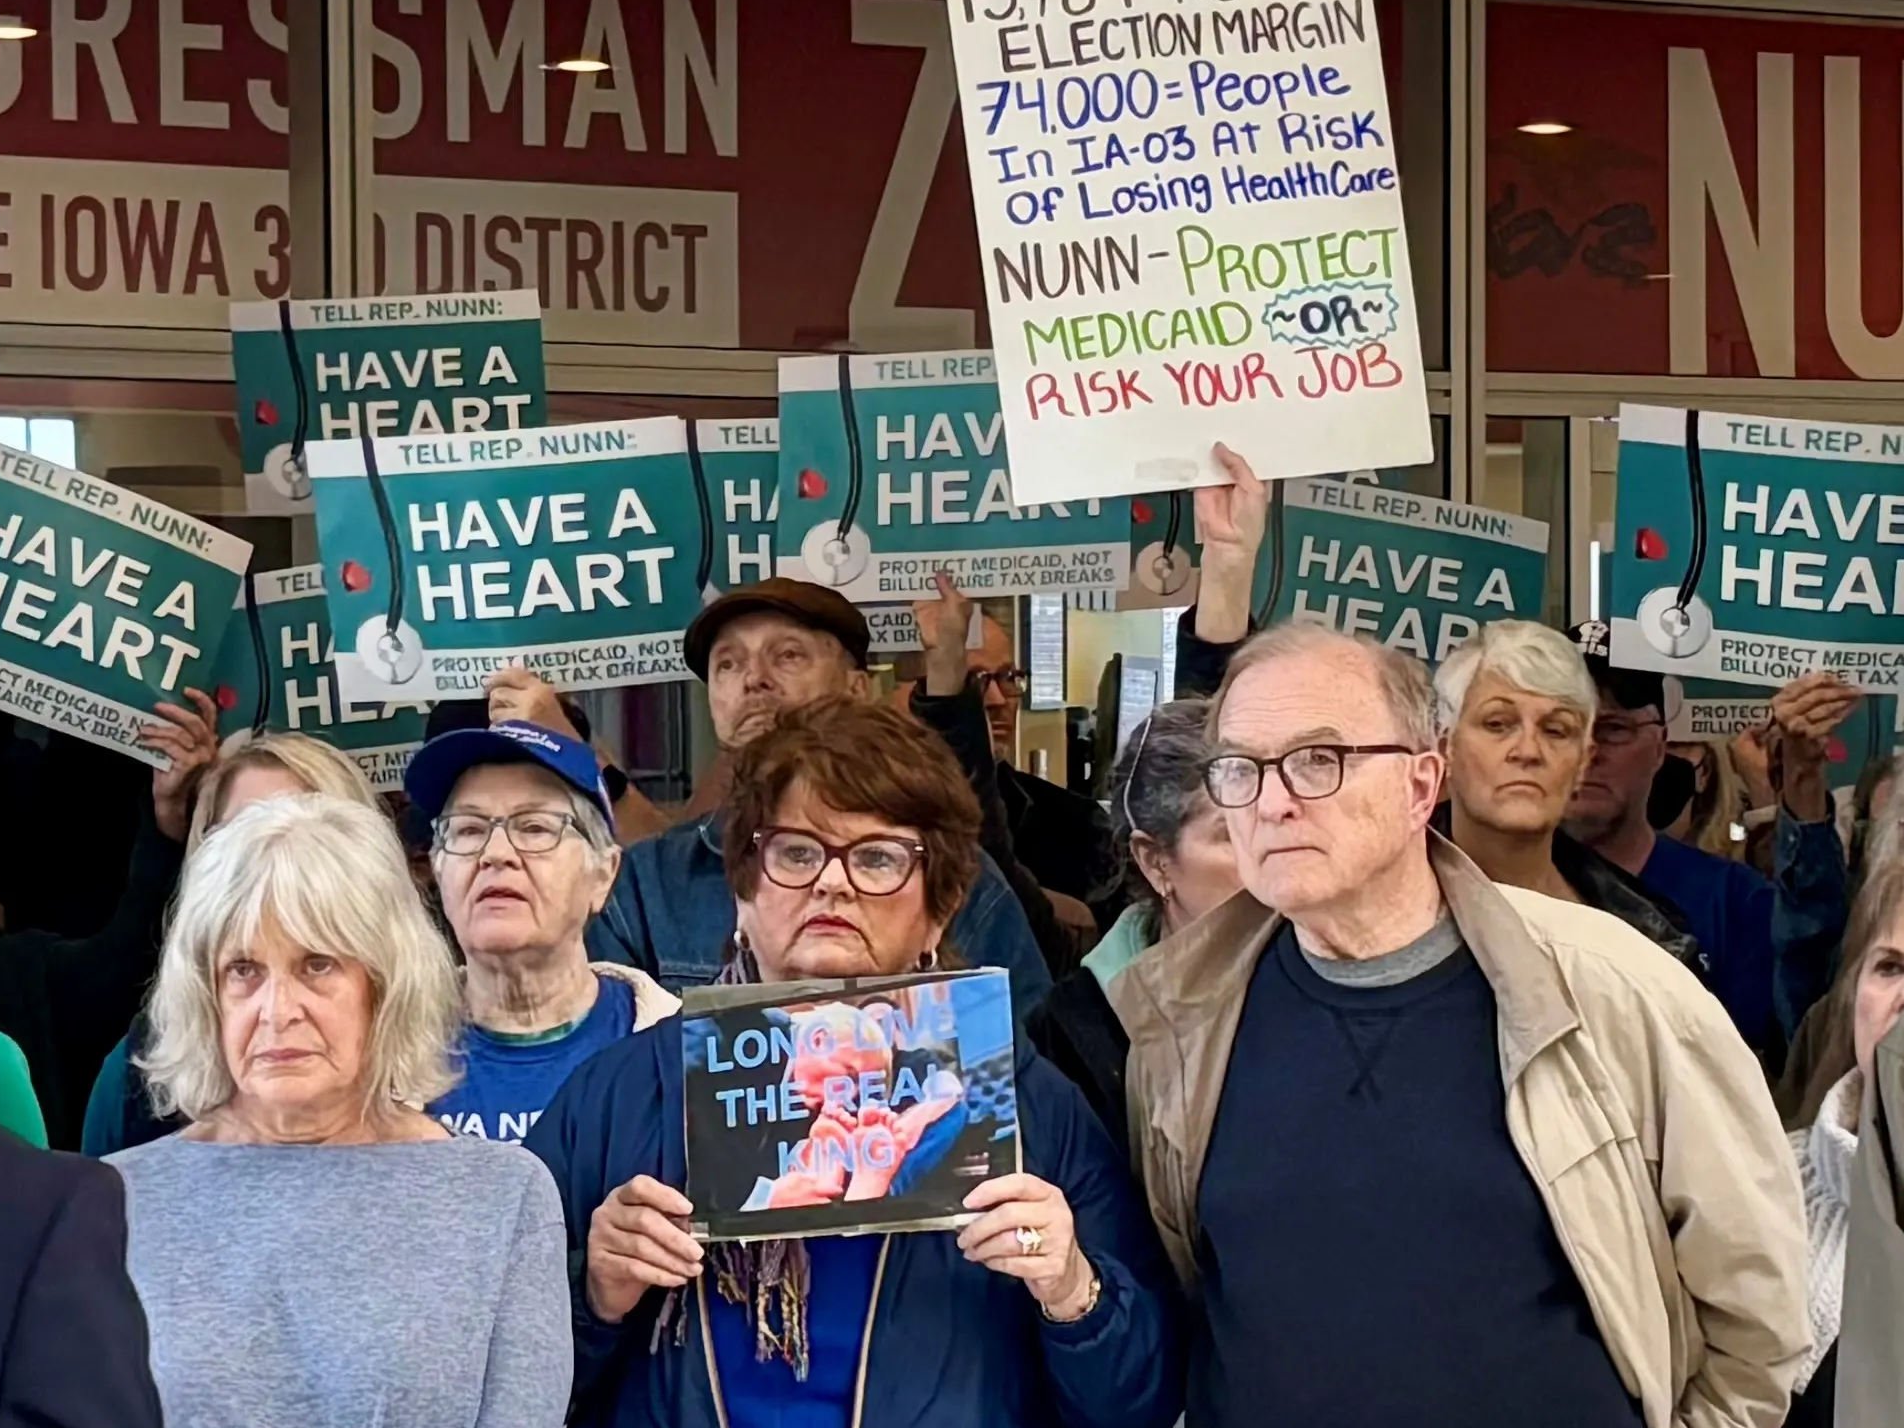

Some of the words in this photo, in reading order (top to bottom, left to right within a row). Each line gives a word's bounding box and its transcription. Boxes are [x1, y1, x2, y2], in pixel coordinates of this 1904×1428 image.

[998, 12, 1202, 74] ELECTION
[1068, 125, 1197, 175] IA-03
[1079, 173, 1213, 221] Losing
[40, 193, 231, 298] IOWA
[416, 211, 708, 315] DISTRICT
[310, 304, 364, 323] TELL
[369, 302, 421, 321] REP.
[425, 298, 503, 319] NUNN:
[1023, 300, 1253, 366] MEDICAID
[315, 346, 464, 393] HAVE
[478, 345, 519, 386] A
[874, 359, 936, 381] TELL
[1026, 369, 1154, 420] RISK
[1163, 351, 1283, 407] YOUR
[1295, 341, 1404, 399] JOB
[399, 443, 463, 467] TELL
[470, 437, 534, 462] REP.
[540, 429, 638, 458] NUNN:
[876, 412, 1004, 461] HAV
[1726, 421, 1795, 450] TELL
[1805, 428, 1870, 455] REP.
[0, 451, 60, 492] TELL
[65, 476, 123, 517] REP.
[129, 501, 214, 553] NUNN:
[408, 491, 590, 552] HAVE
[607, 486, 658, 540] A
[1308, 483, 1366, 512] TELL
[1373, 497, 1427, 522] REP.
[1435, 505, 1514, 539] NUNN:
[414, 545, 676, 622] HEART
[879, 555, 966, 576] PROTECT
[971, 552, 1068, 573] MEDICAID,
[1071, 550, 1113, 568] NOT
[999, 570, 1037, 588] TAX
[1039, 566, 1116, 586] BREAKS
[1297, 534, 1464, 603] HAVE
[1474, 567, 1516, 613] A
[153, 580, 196, 631] A
[1292, 589, 1484, 663] HEAR
[556, 664, 604, 684] TAX
[1720, 637, 1817, 664] PROTECT
[1856, 670, 1898, 686] TAX
[23, 678, 122, 730] MEDICAID,
[50, 704, 93, 732] TAX
[706, 1020, 836, 1074] LONG
[852, 996, 960, 1053] LIVE
[715, 1083, 810, 1129] THE
[822, 1062, 962, 1113] REAL
[777, 1127, 895, 1179] KING
